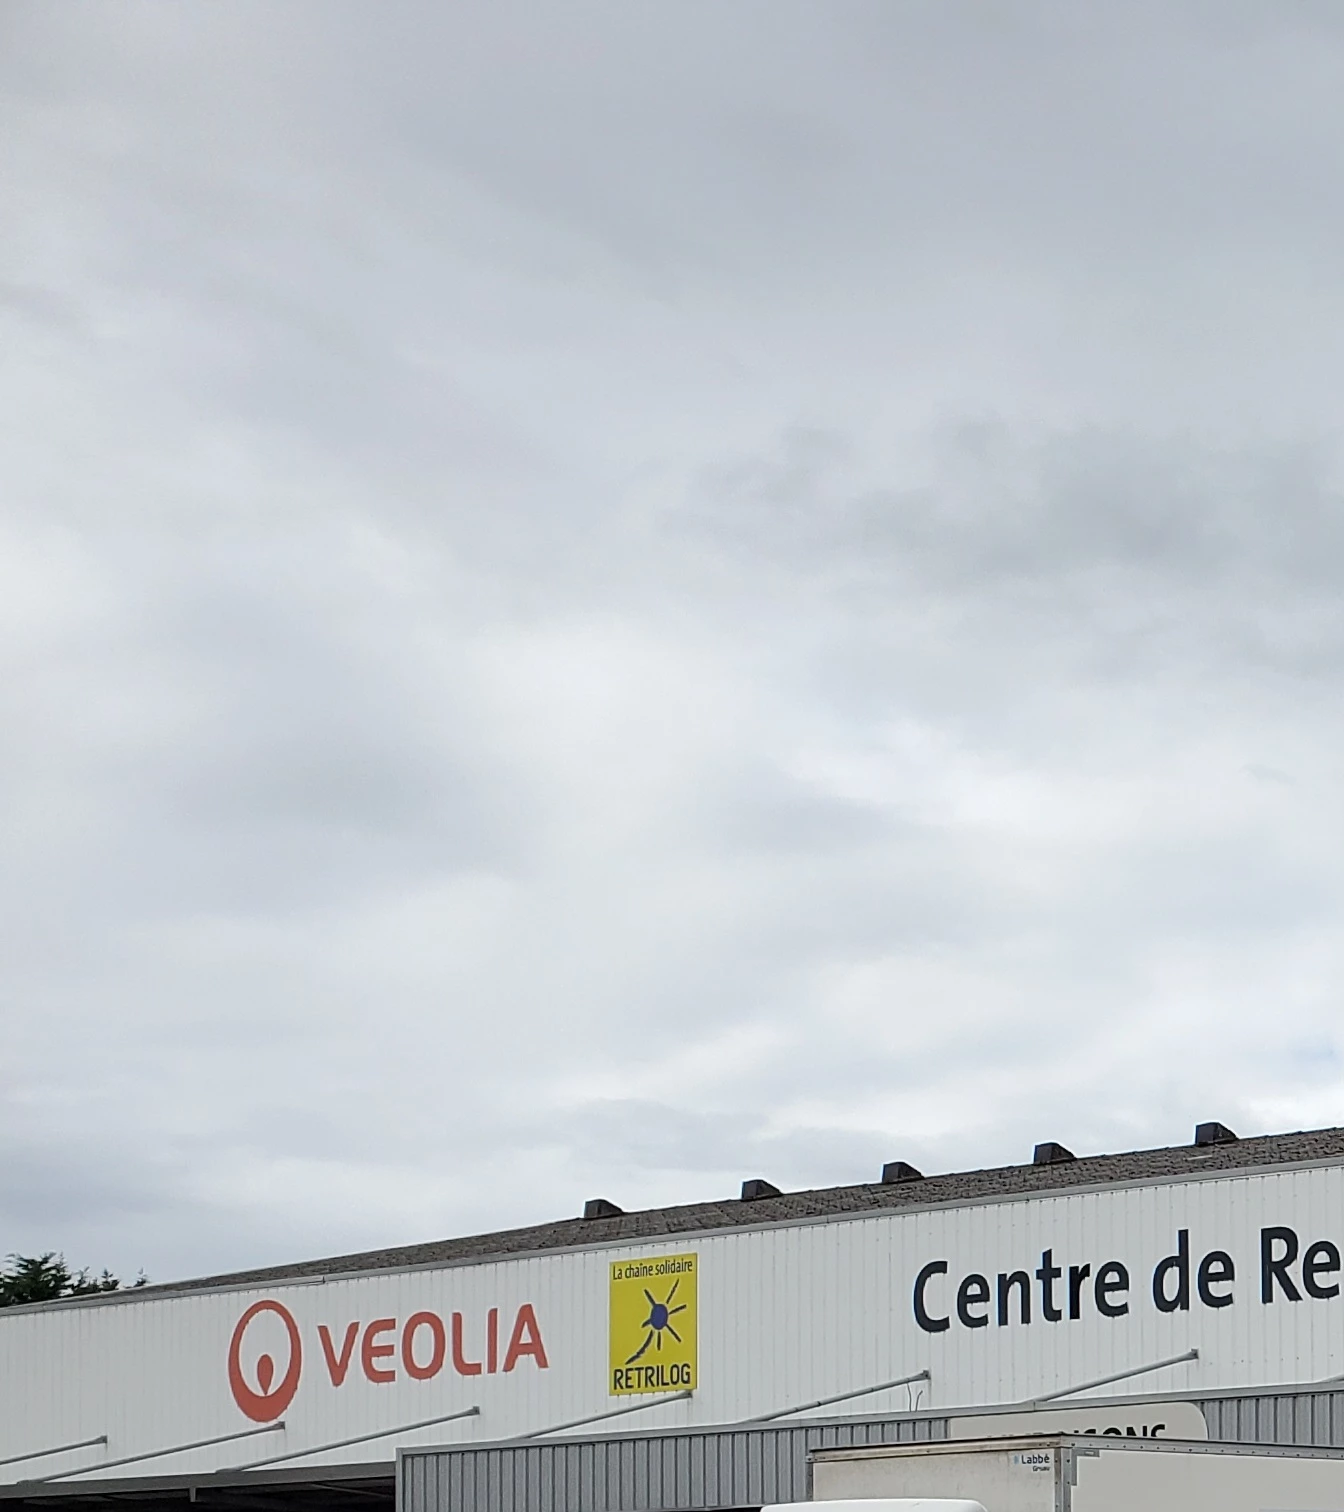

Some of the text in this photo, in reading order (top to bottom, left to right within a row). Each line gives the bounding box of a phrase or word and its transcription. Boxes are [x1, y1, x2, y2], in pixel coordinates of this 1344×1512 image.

[612, 1257, 693, 1280] La chaîne solidaire
[913, 1247, 1130, 1333] Centre
[1152, 1229, 1235, 1312] de
[317, 1303, 549, 1388] VEOLIA
[613, 1363, 691, 1390] RETRILOG
